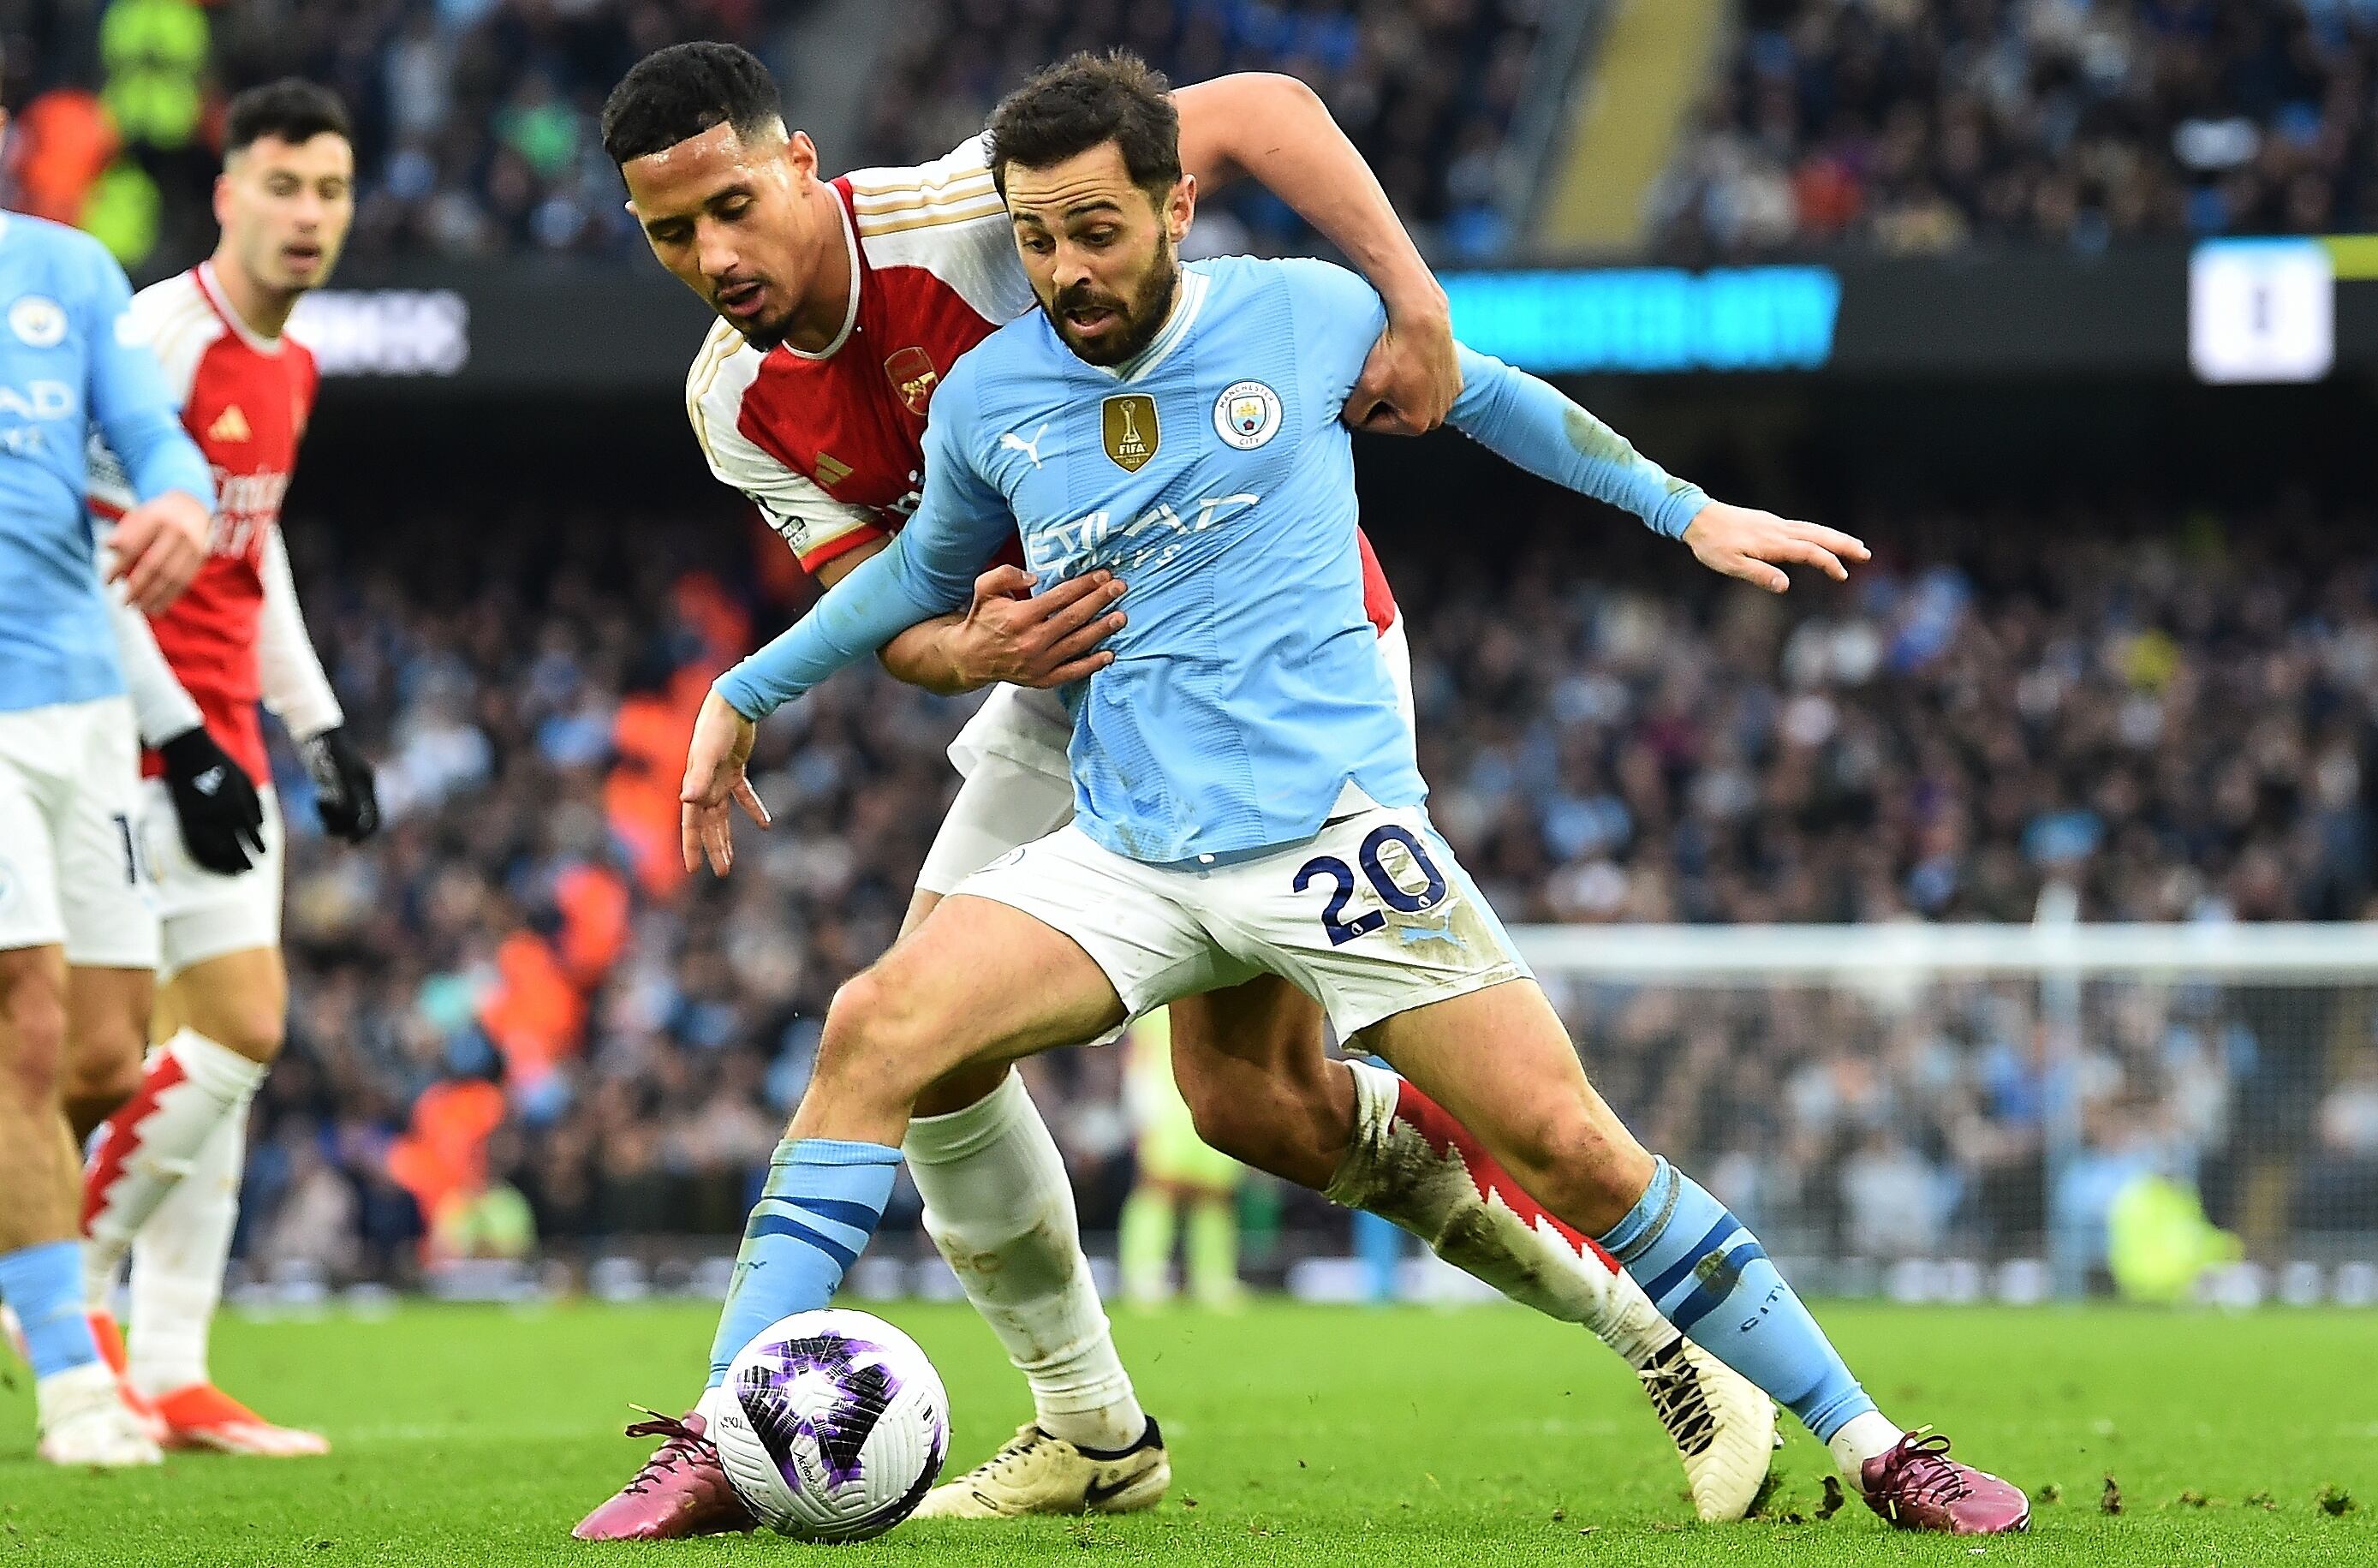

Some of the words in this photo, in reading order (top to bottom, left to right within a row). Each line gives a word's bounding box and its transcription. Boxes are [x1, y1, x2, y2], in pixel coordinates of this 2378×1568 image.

[1219, 385, 1275, 408] MANCHESTER
[1118, 443, 1146, 455] FIFA
[1238, 437, 1260, 445] CITY
[1292, 824, 1446, 947] 20
[1739, 1282, 1786, 1333] CITY
